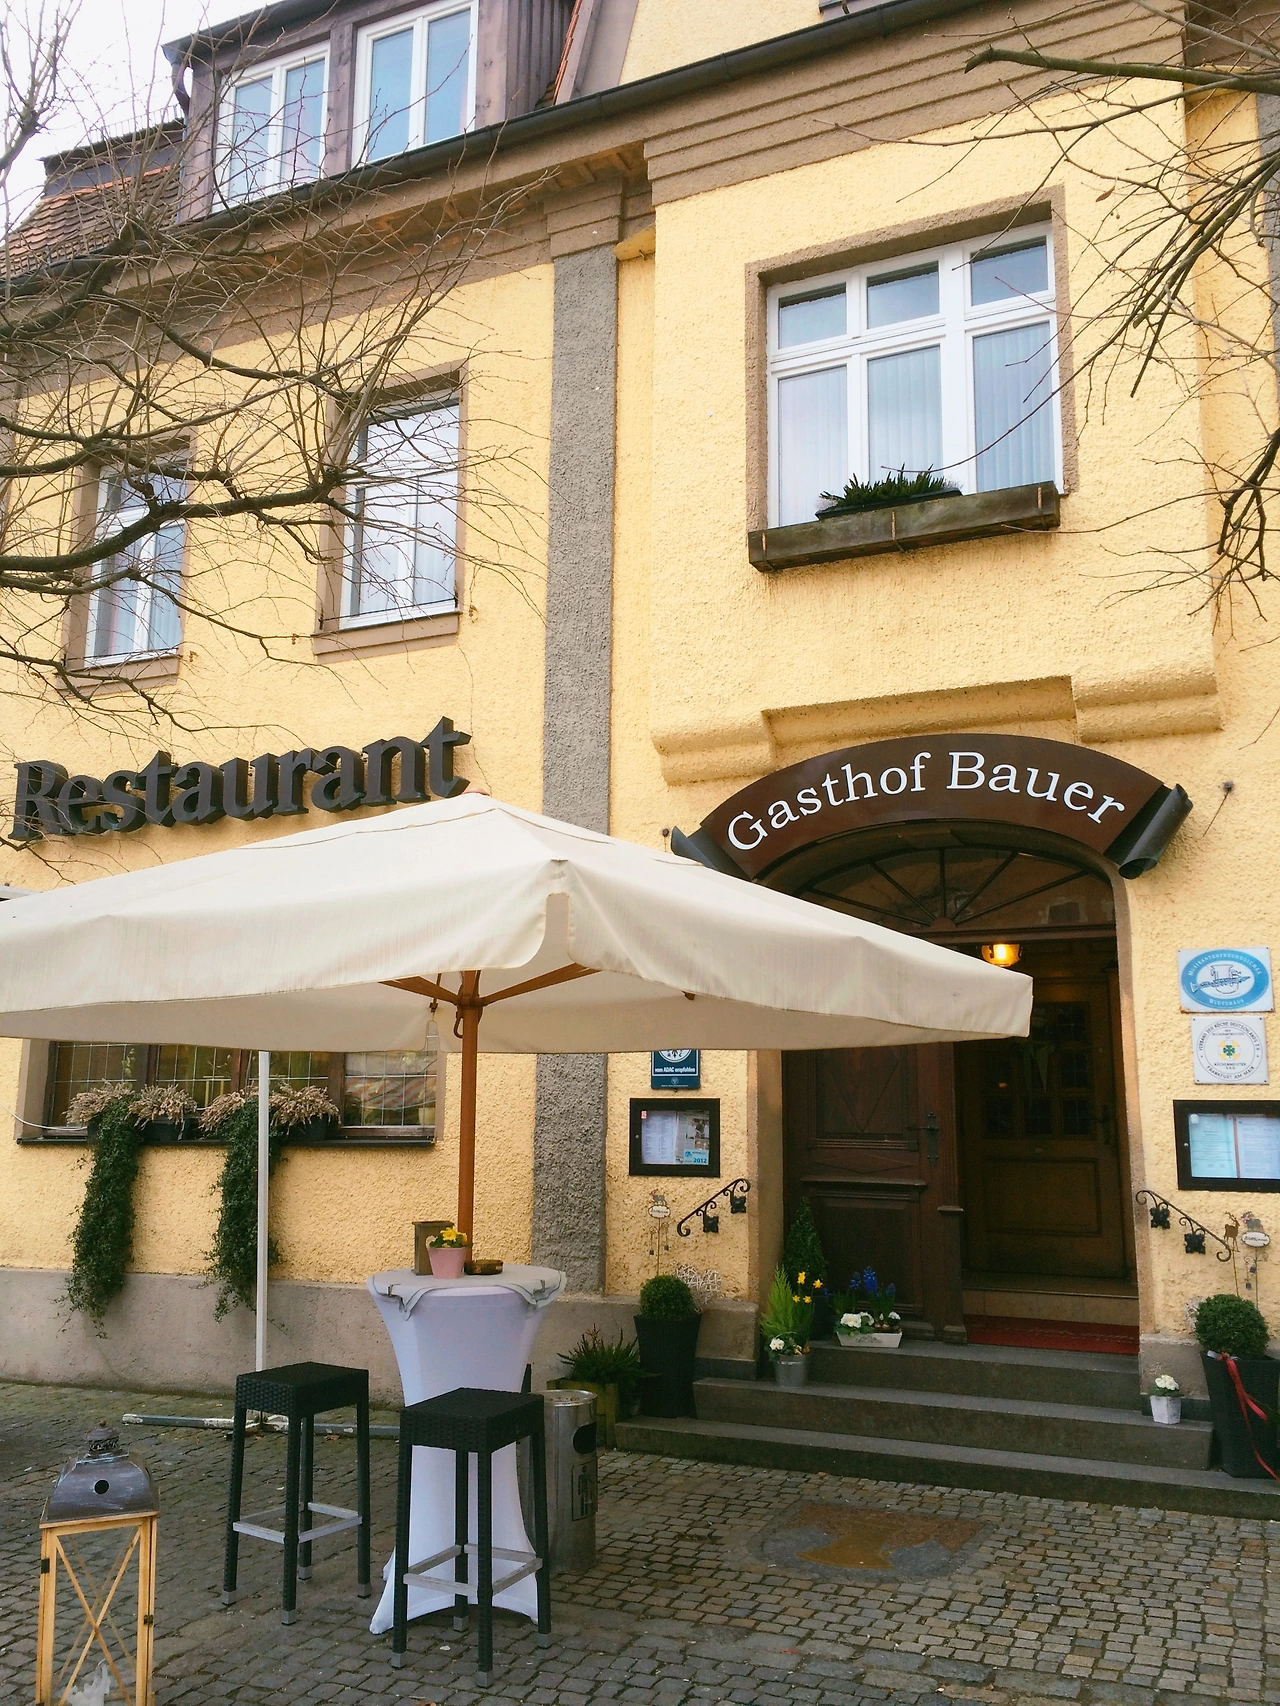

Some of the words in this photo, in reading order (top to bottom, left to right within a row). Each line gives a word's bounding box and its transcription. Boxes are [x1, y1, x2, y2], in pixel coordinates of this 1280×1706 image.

[8, 716, 472, 840] Restaurant
[727, 751, 931, 851] Gasthof
[946, 751, 1125, 824] Bauer
[1209, 998, 1245, 1006] WIRTSHAUS
[1206, 1065, 1232, 1079] FRANKFURT
[1243, 1065, 1255, 1075] MAIN
